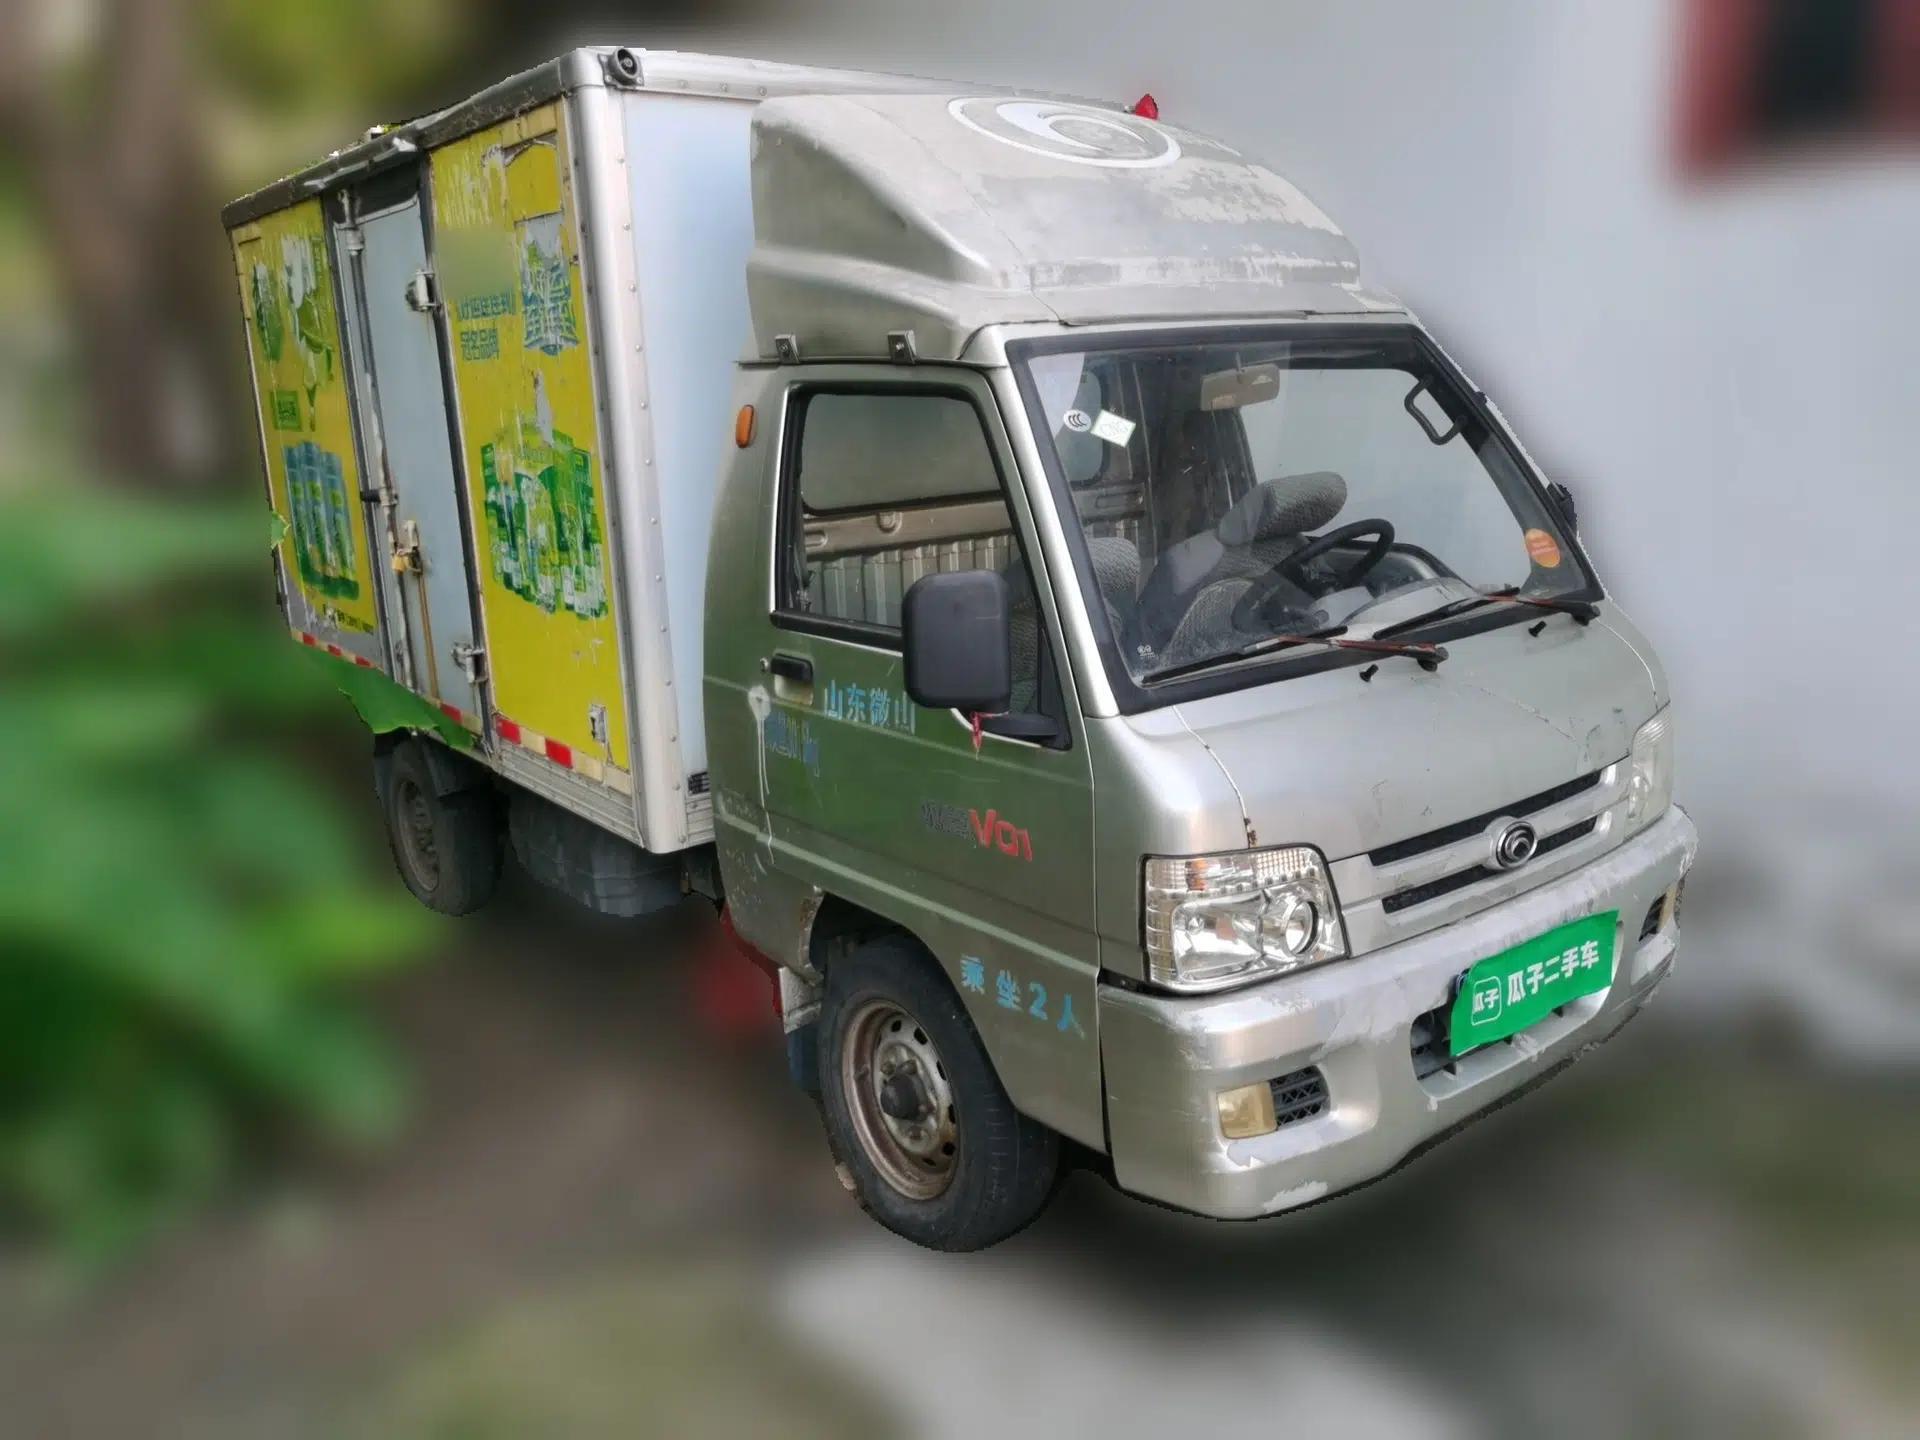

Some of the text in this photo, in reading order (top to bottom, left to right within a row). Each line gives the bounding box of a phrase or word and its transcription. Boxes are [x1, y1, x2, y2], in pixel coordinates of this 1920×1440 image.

[1507, 941, 1600, 1006] 瓜子二手车
[1473, 988, 1499, 1012] 瓜子
